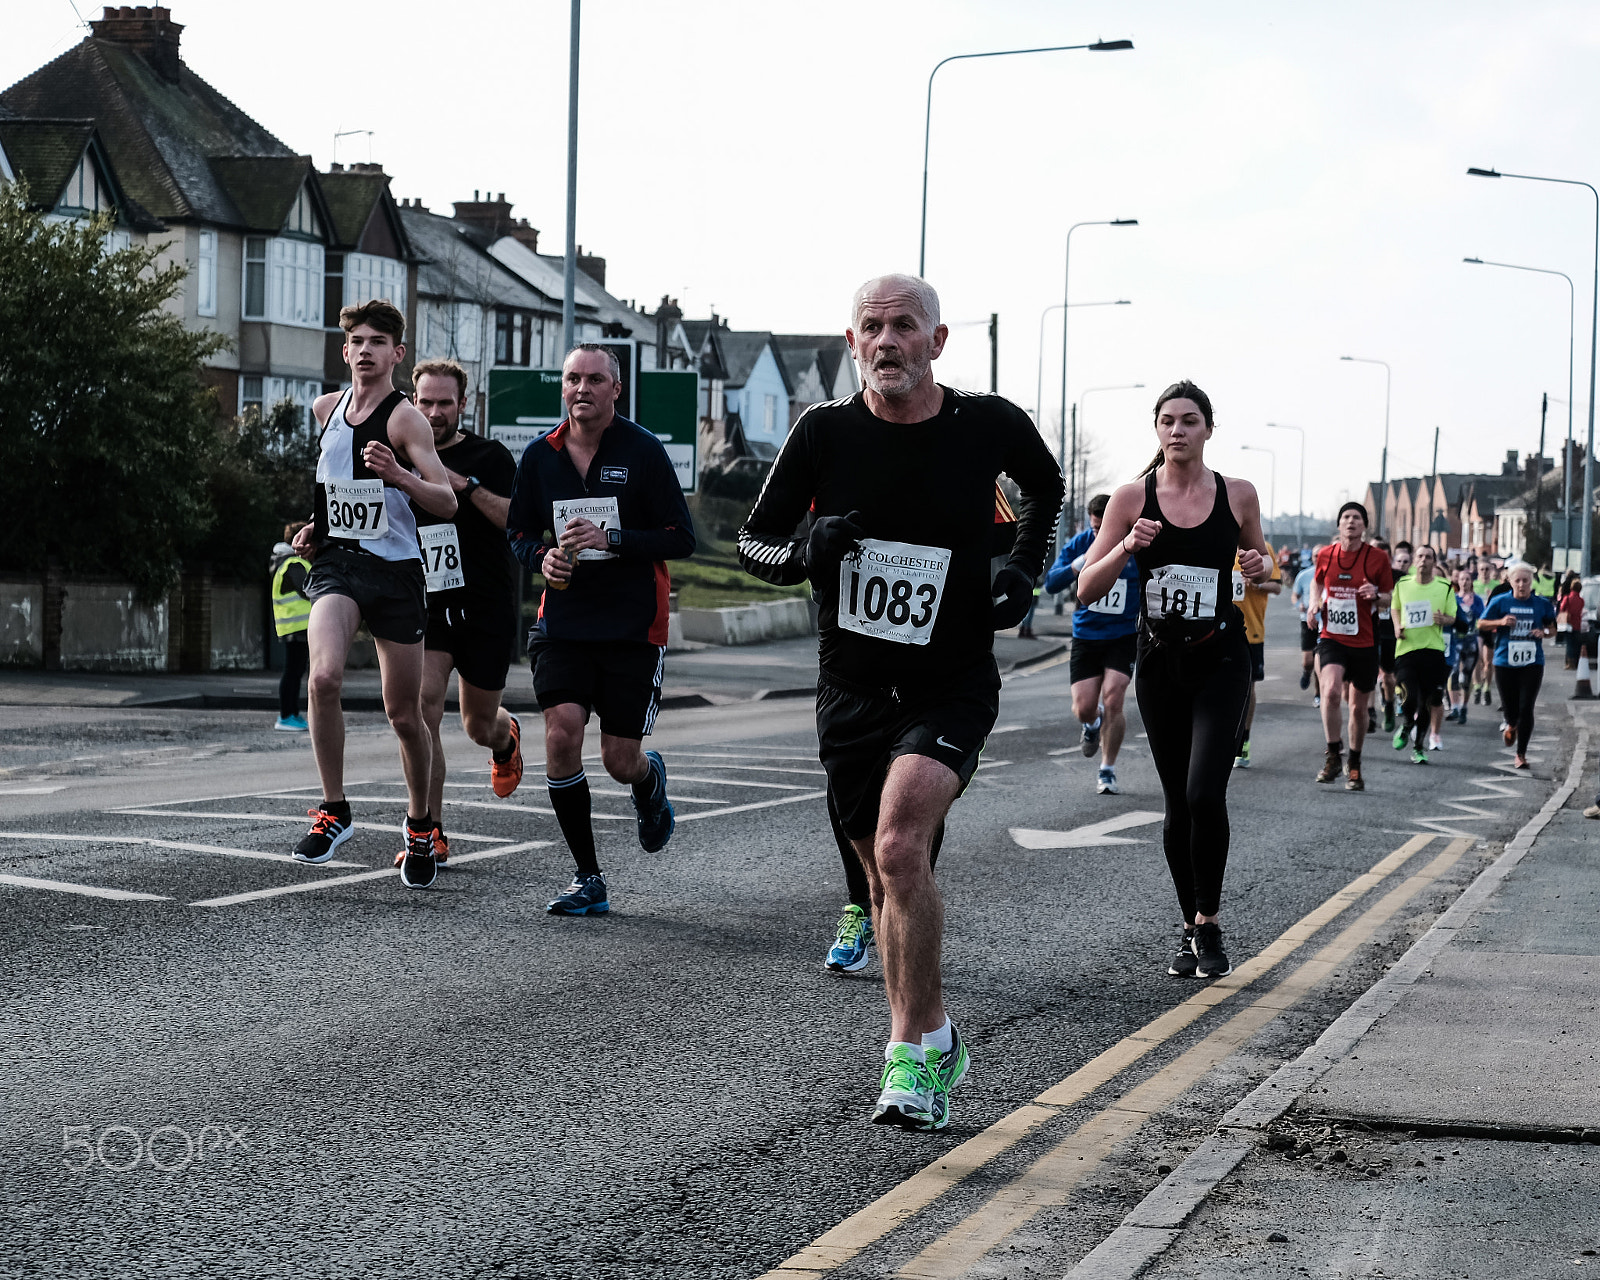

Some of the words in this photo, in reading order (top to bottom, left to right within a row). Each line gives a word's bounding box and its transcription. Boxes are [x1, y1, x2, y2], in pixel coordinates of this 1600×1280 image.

[493, 432, 535, 441] Clacton
[337, 487, 382, 495] COLCHESTER
[329, 500, 384, 530] 3097
[569, 505, 616, 515] COLCHESTER
[422, 545, 459, 574] 178
[867, 551, 944, 571] COLCHESTER
[867, 563, 889, 573] HALF
[893, 568, 941, 580] MARATHON
[1166, 573, 1215, 584] COLCHESTER
[443, 577, 460, 588] 1178
[849, 570, 938, 628] 1083
[1160, 587, 1202, 617] 181
[1328, 609, 1356, 625] 3088
[1409, 610, 1427, 624] 237
[1512, 651, 1532, 662] 613
